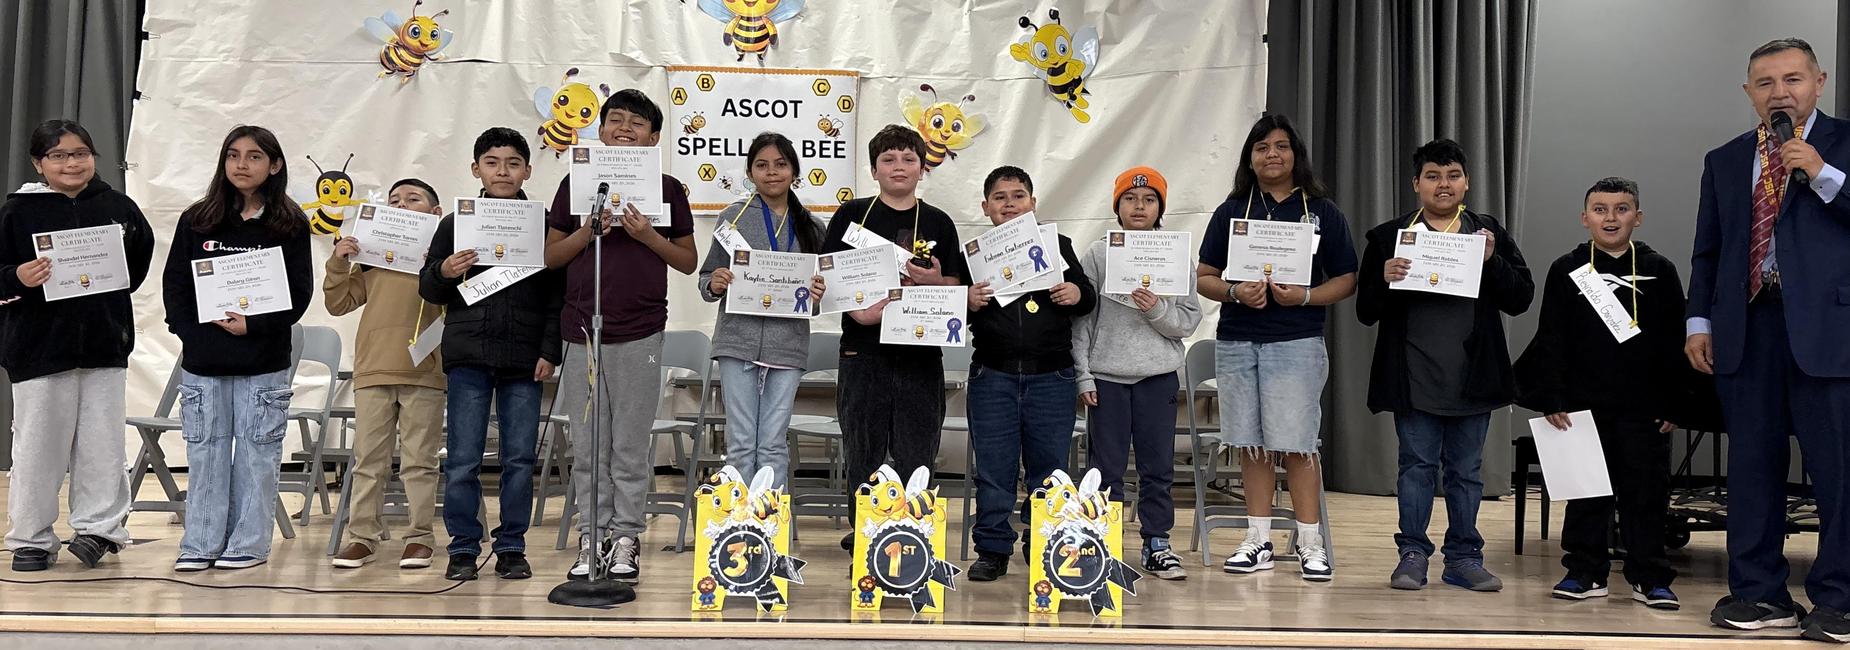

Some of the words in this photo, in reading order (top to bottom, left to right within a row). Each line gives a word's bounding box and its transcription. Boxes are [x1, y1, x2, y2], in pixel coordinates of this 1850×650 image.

[701, 78, 710, 89] B
[817, 82, 826, 93] C
[674, 89, 683, 100] A
[721, 98, 803, 119] ASCOT
[842, 99, 851, 110] D
[677, 137, 793, 157] SPELL
[802, 140, 847, 159] BEE
[1760, 150, 1769, 169] USC
[702, 167, 712, 179] X
[813, 172, 822, 183] Y
[1763, 177, 1775, 197] USC
[840, 191, 849, 202] Z
[483, 208, 525, 216] CERTIFICATE
[1423, 240, 1465, 249] CERTIFICATE
[757, 260, 798, 268] CERTIFICATE
[841, 255, 879, 266] CERTIFICATE
[468, 281, 503, 299] Julian
[909, 293, 949, 301] CERTIFICATE
[902, 306, 928, 315] William
[723, 541, 762, 578] 3rd
[884, 541, 917, 578] 1ST
[1058, 543, 1096, 578] 2nd
